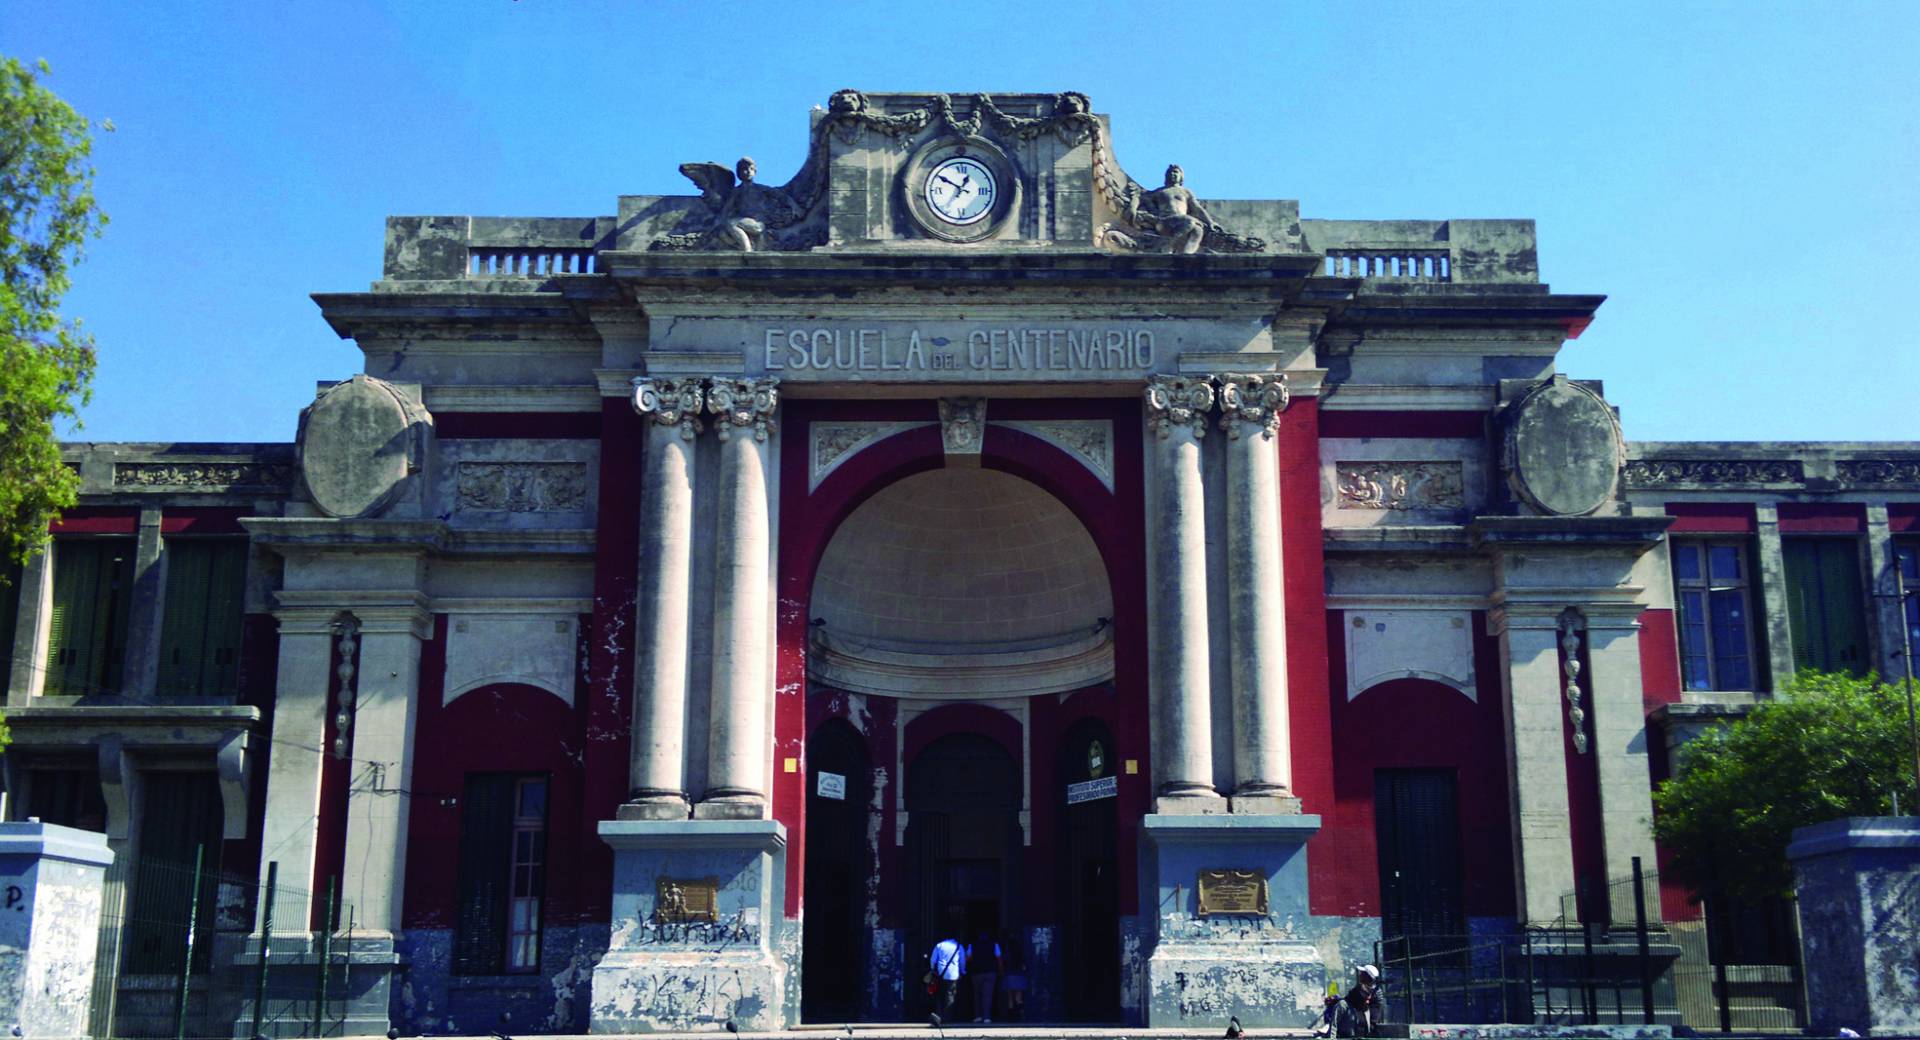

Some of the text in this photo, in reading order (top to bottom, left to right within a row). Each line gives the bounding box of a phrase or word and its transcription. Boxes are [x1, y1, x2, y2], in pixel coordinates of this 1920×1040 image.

[765, 328, 1155, 370] ESCUELA DEL CENTENARIO
